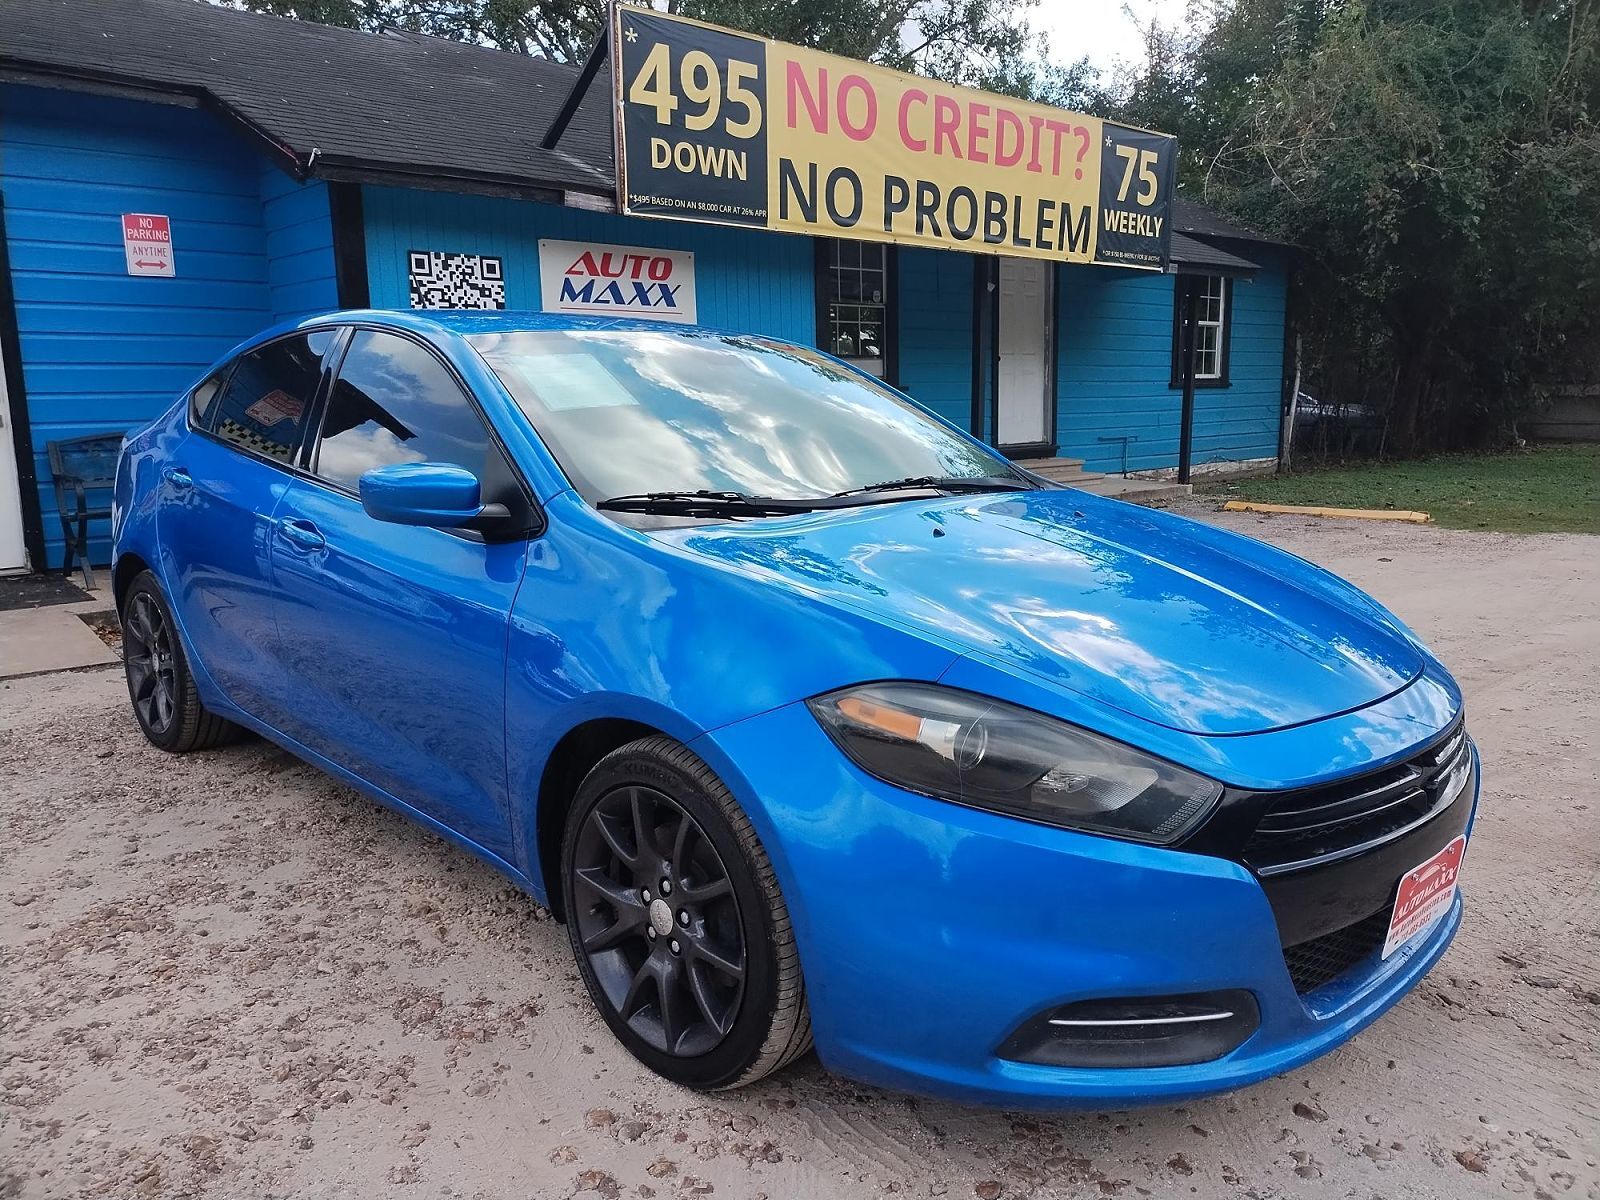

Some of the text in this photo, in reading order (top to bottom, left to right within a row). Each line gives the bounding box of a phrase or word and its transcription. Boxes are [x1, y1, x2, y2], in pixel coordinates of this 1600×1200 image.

[786, 60, 1091, 181] NO CREDIT?
[651, 137, 747, 181] DOWN
[651, 196, 674, 207] BASED
[674, 199, 686, 208] ON
[686, 200, 697, 210] AN
[698, 202, 719, 212] $8,000
[719, 204, 732, 213] CAR
[732, 205, 741, 215] AT
[741, 207, 754, 216] 26%
[754, 208, 767, 218] APR
[779, 157, 1091, 254] NO PROBLEM
[127, 228, 169, 241] PARKING
[139, 218, 153, 228] NO
[1104, 208, 1163, 238] WEEKLY
[133, 246, 167, 257] ANYTIME
[564, 251, 673, 281] AUTO
[560, 277, 681, 308] MAXX
[1393, 866, 1457, 924] AUTOMAXX
